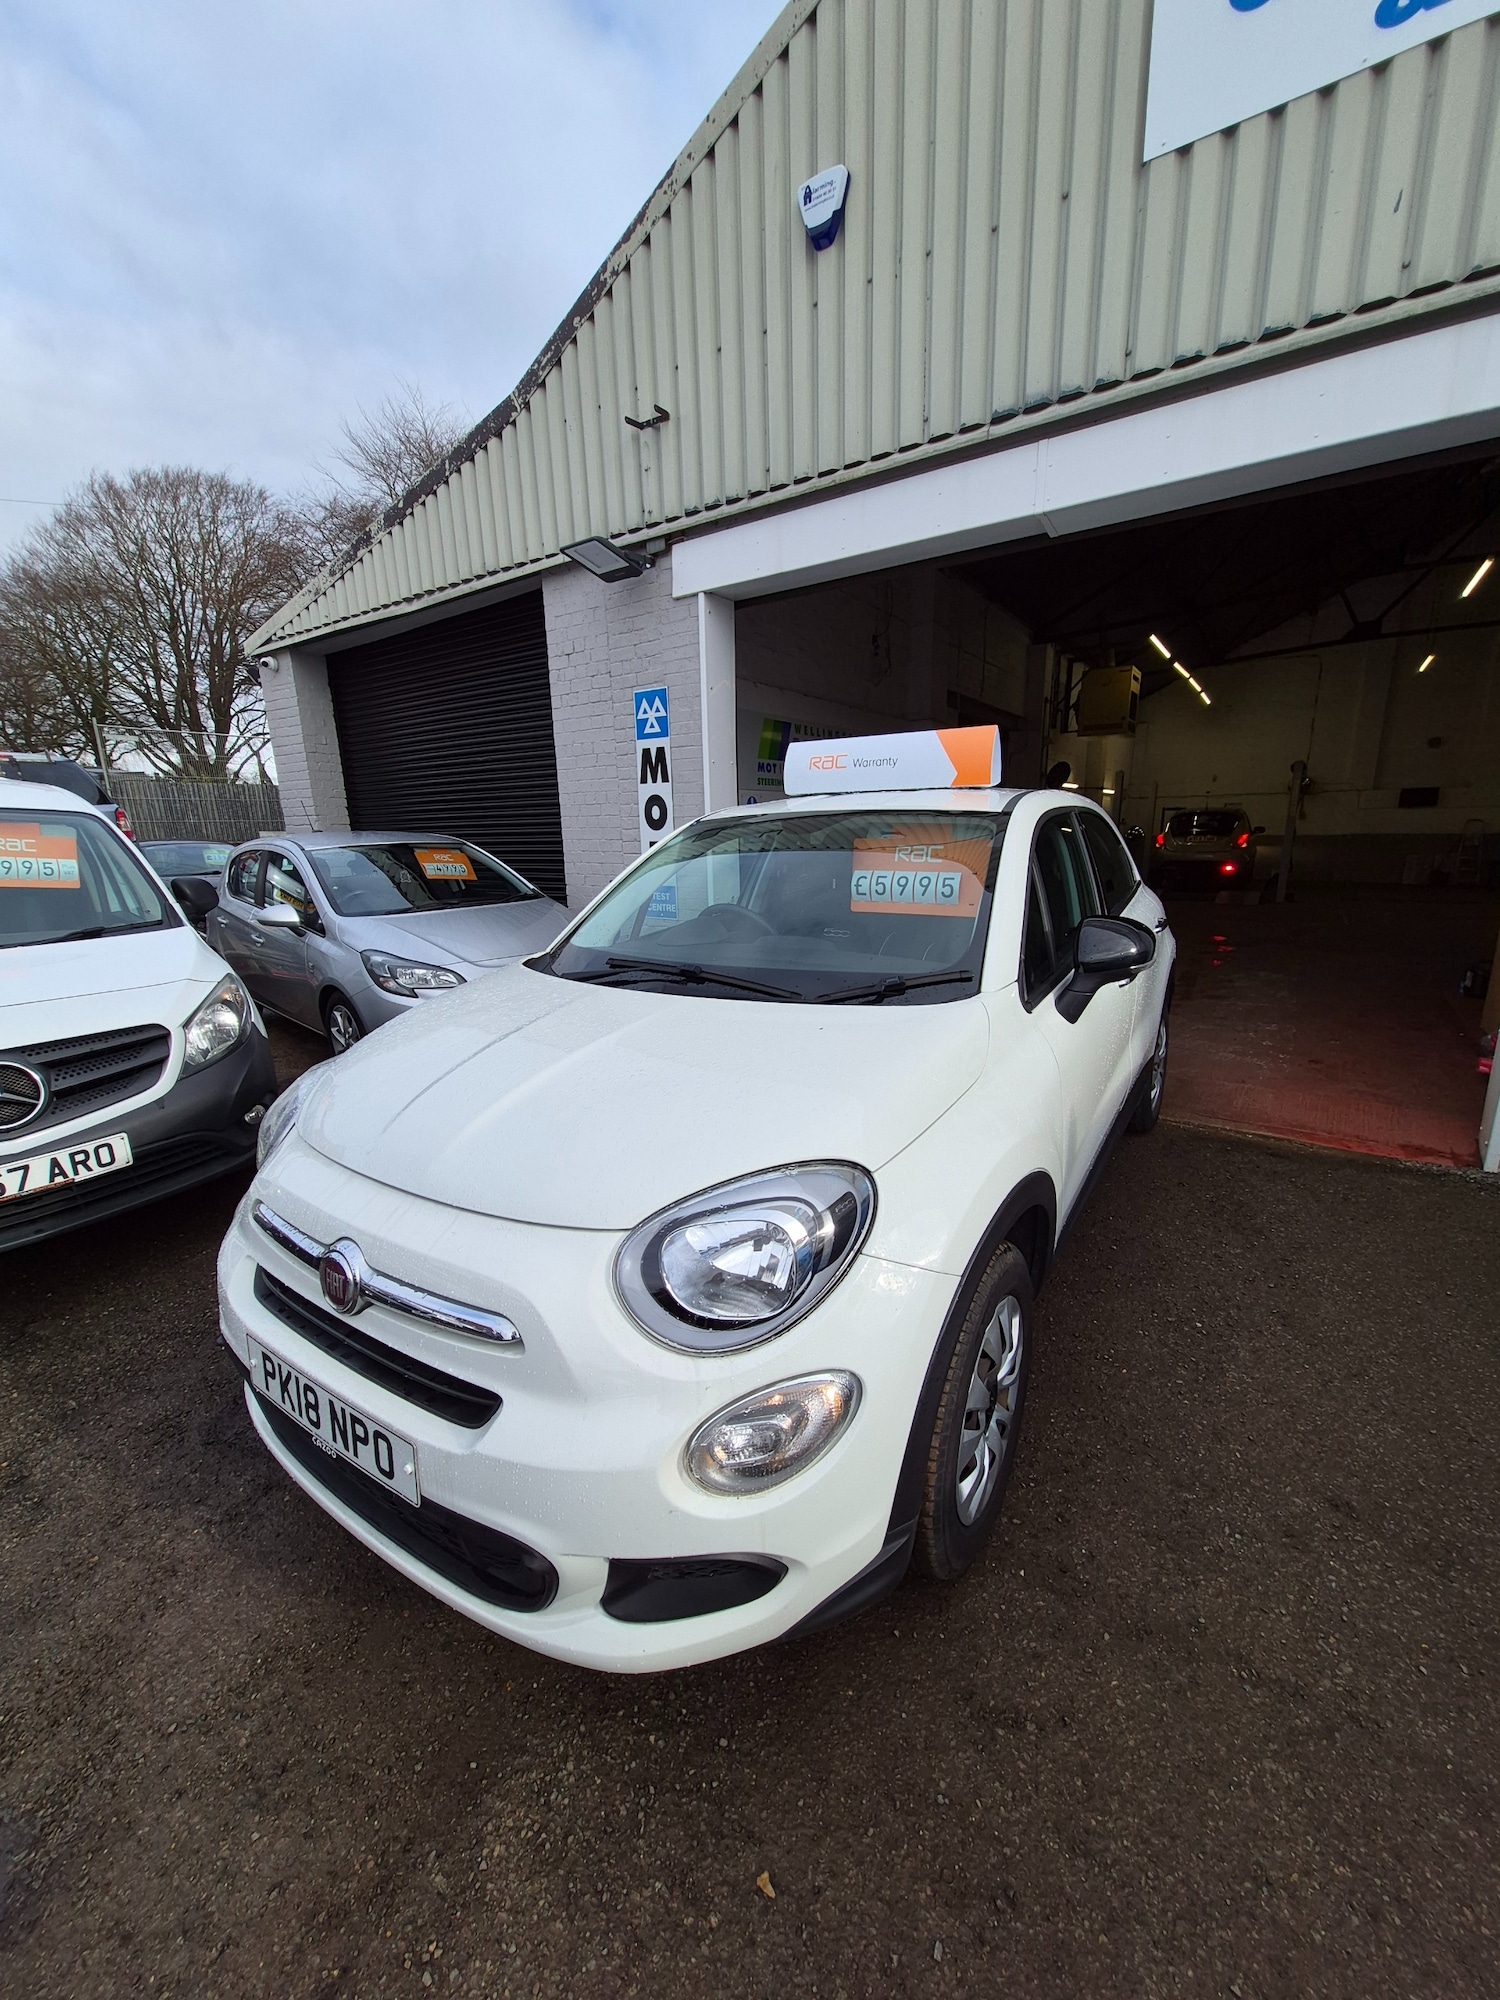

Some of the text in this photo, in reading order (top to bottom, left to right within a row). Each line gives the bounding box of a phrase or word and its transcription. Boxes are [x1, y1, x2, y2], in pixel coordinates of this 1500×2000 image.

[757, 761, 777, 774] MOT
[852, 757, 898, 768] Warranty
[640, 746, 670, 849] MO
[854, 875, 955, 898] £5995
[49, 1143, 116, 1184] ARO
[325, 1267, 346, 1300] FIAT
[261, 1351, 395, 1481] PK18 NPO
[312, 1436, 337, 1459] CAZOO
